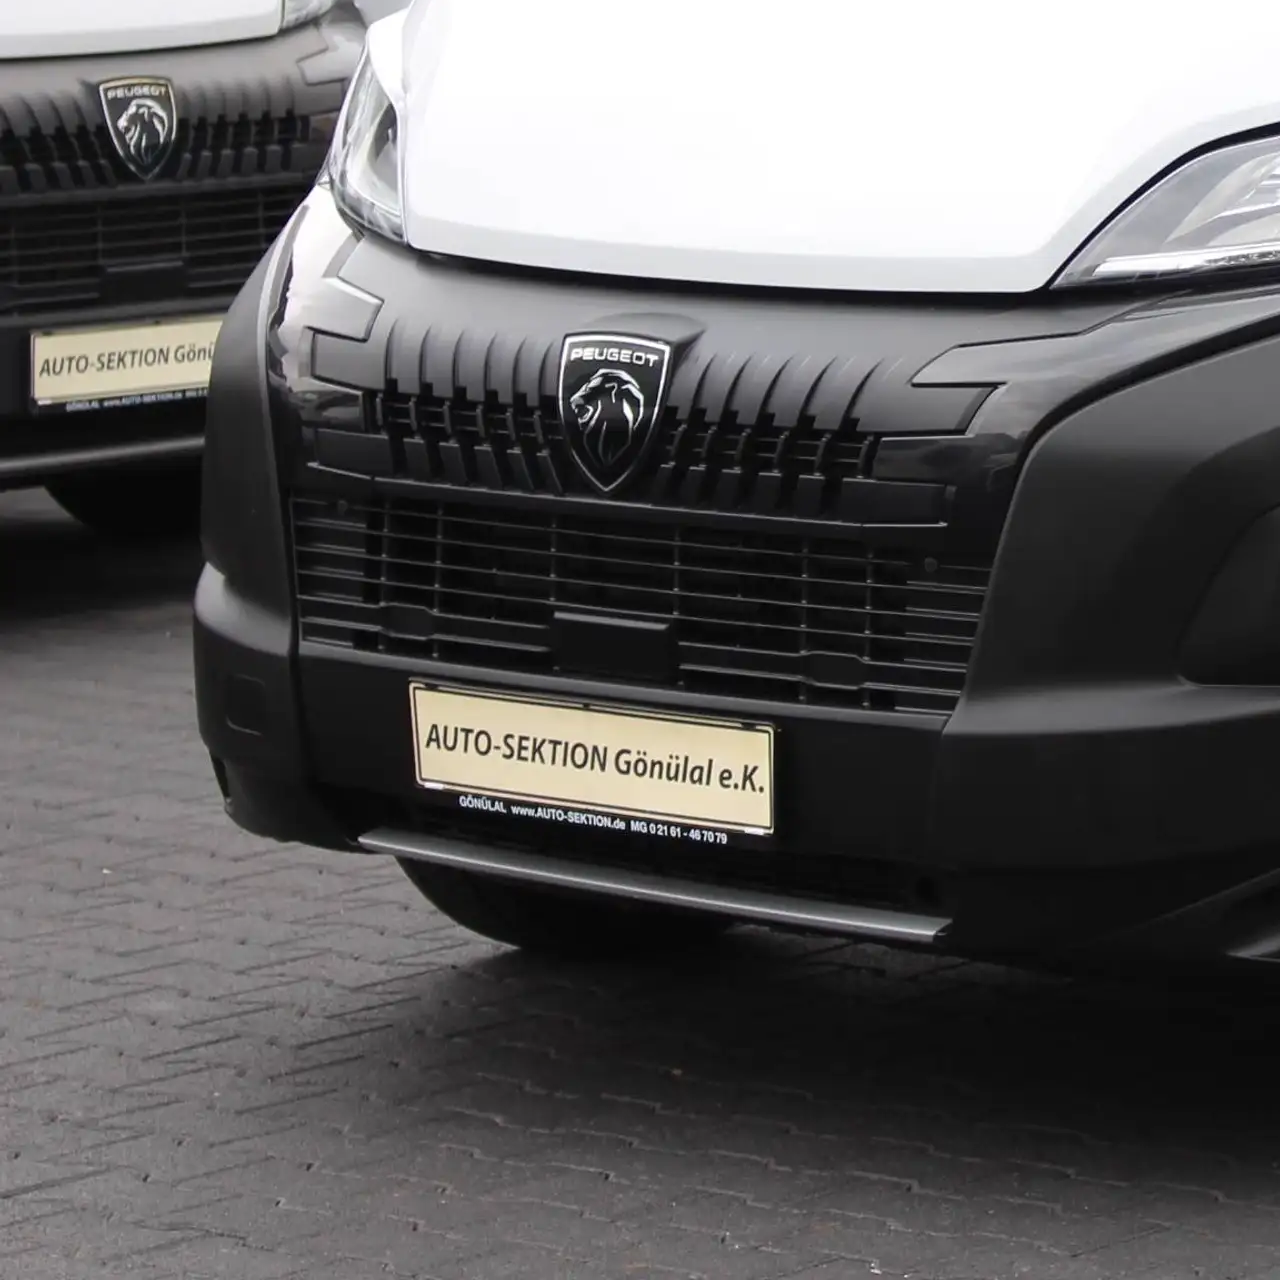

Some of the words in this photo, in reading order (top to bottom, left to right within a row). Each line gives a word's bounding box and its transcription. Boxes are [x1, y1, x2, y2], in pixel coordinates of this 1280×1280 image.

[106, 85, 166, 100] PEUGEOT
[39, 346, 170, 378] AUTO-SEKTION
[569, 347, 659, 367] PEUGEOT
[425, 723, 608, 773] AUTO-SEKTION
[613, 748, 714, 787] Gönülal
[718, 764, 765, 794] e.K.
[459, 794, 507, 814] GÖNÜLAL
[510, 805, 626, 830] www.AUTO-SEKTION.de
[630, 819, 648, 834] MG
